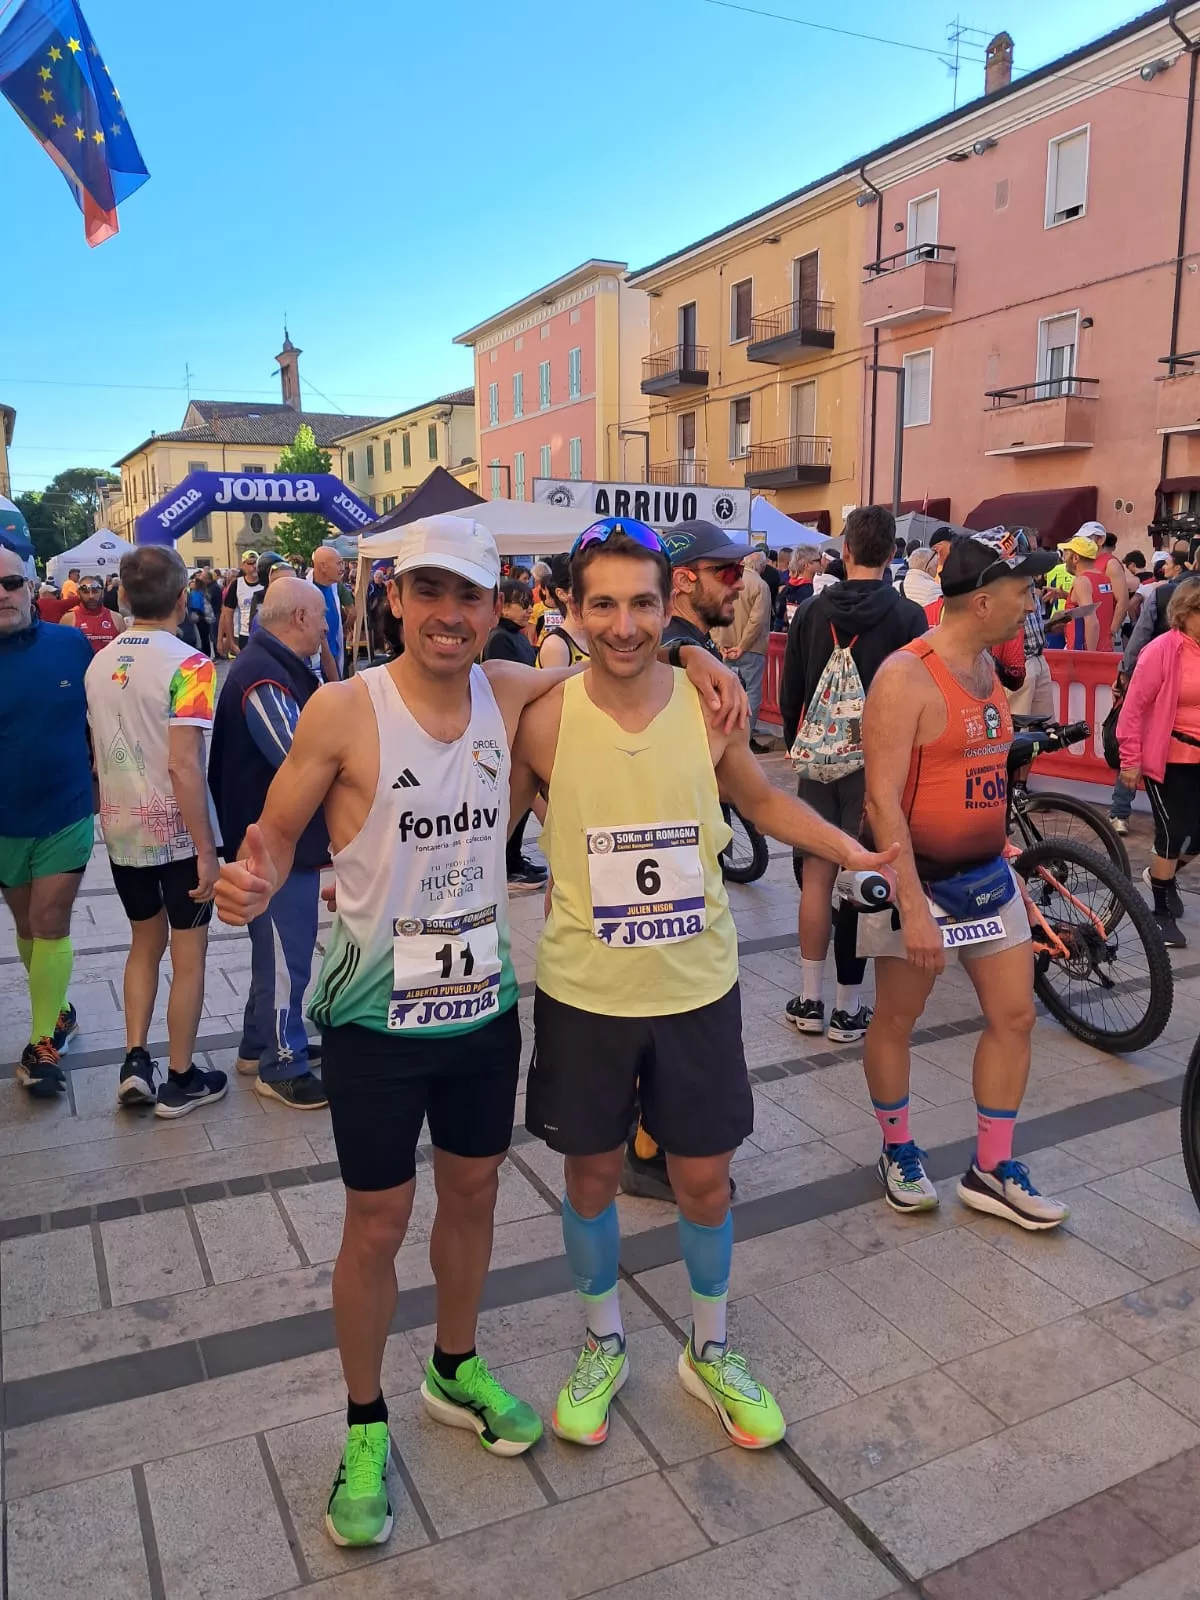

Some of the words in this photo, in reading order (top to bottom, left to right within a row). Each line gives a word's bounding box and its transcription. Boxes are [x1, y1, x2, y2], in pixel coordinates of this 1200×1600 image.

[215, 477, 320, 503] Joma
[595, 489, 697, 523] ARRIVO
[473, 740, 499, 749] OROEL
[965, 800, 999, 809] RIOLO
[616, 833, 642, 844] 50Km
[645, 831, 653, 841] di
[656, 827, 696, 840] ROMAGNA
[636, 858, 661, 895] 6
[627, 904, 650, 915] JULIEN
[426, 920, 453, 929] 50Km
[622, 914, 704, 944] Joma
[946, 921, 1003, 945] Joma
[435, 941, 474, 978] 11
[406, 987, 438, 998] ALBERTO
[440, 983, 471, 995] PUYUELO
[417, 991, 495, 1024] Joma
